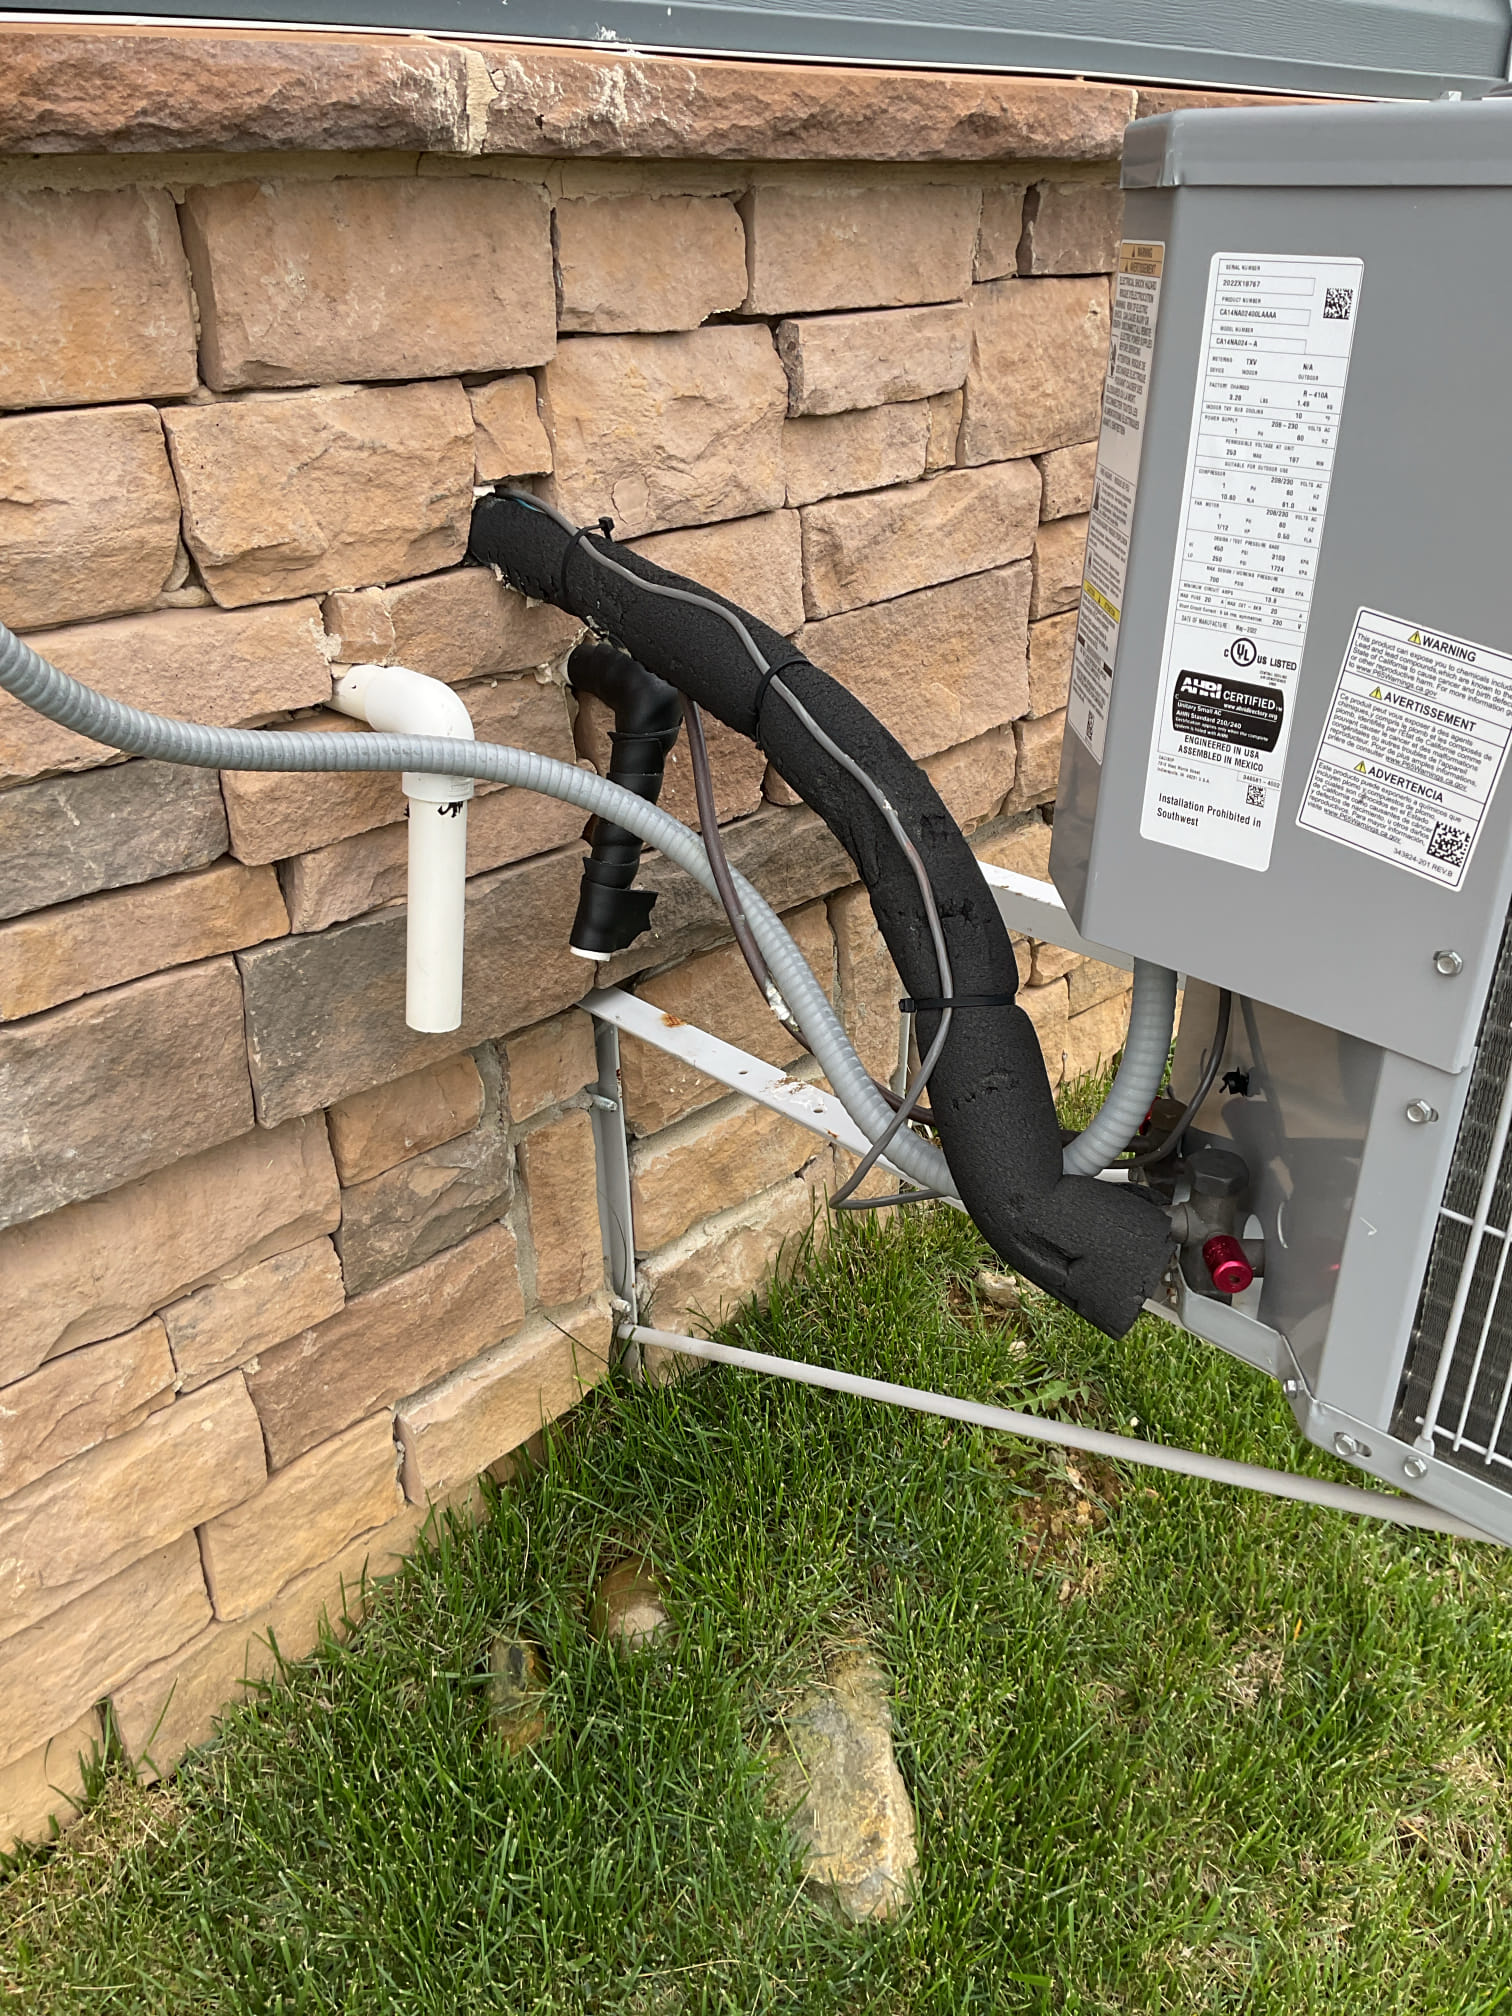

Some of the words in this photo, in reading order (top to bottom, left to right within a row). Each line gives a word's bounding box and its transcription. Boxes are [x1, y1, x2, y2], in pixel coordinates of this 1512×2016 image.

[1420, 635, 1477, 662] WARNING
[1256, 655, 1267, 664] US
[1269, 657, 1297, 670] LISTED
[1180, 675, 1222, 699] AHRI
[1223, 690, 1276, 710] CERTIFIED
[1177, 701, 1196, 711] Unitary
[1196, 705, 1213, 714] Small
[1190, 712, 1215, 723] Standard
[1216, 718, 1241, 729] 210/240
[1383, 690, 1477, 732] AVERTISSEMENT
[1178, 744, 1221, 762] ASSEMBLED
[1223, 755, 1232, 764] IN
[1234, 757, 1263, 772] MEXICO
[1184, 734, 1231, 752] ENGINEERED
[1233, 745, 1241, 755] IN
[1243, 748, 1260, 759] USA
[1367, 765, 1445, 803] ADVERTENCIA
[1156, 807, 1198, 826] Southwest
[1158, 792, 1204, 813] Installation
[1206, 805, 1250, 825] Prohibited
[1252, 817, 1261, 828] in
